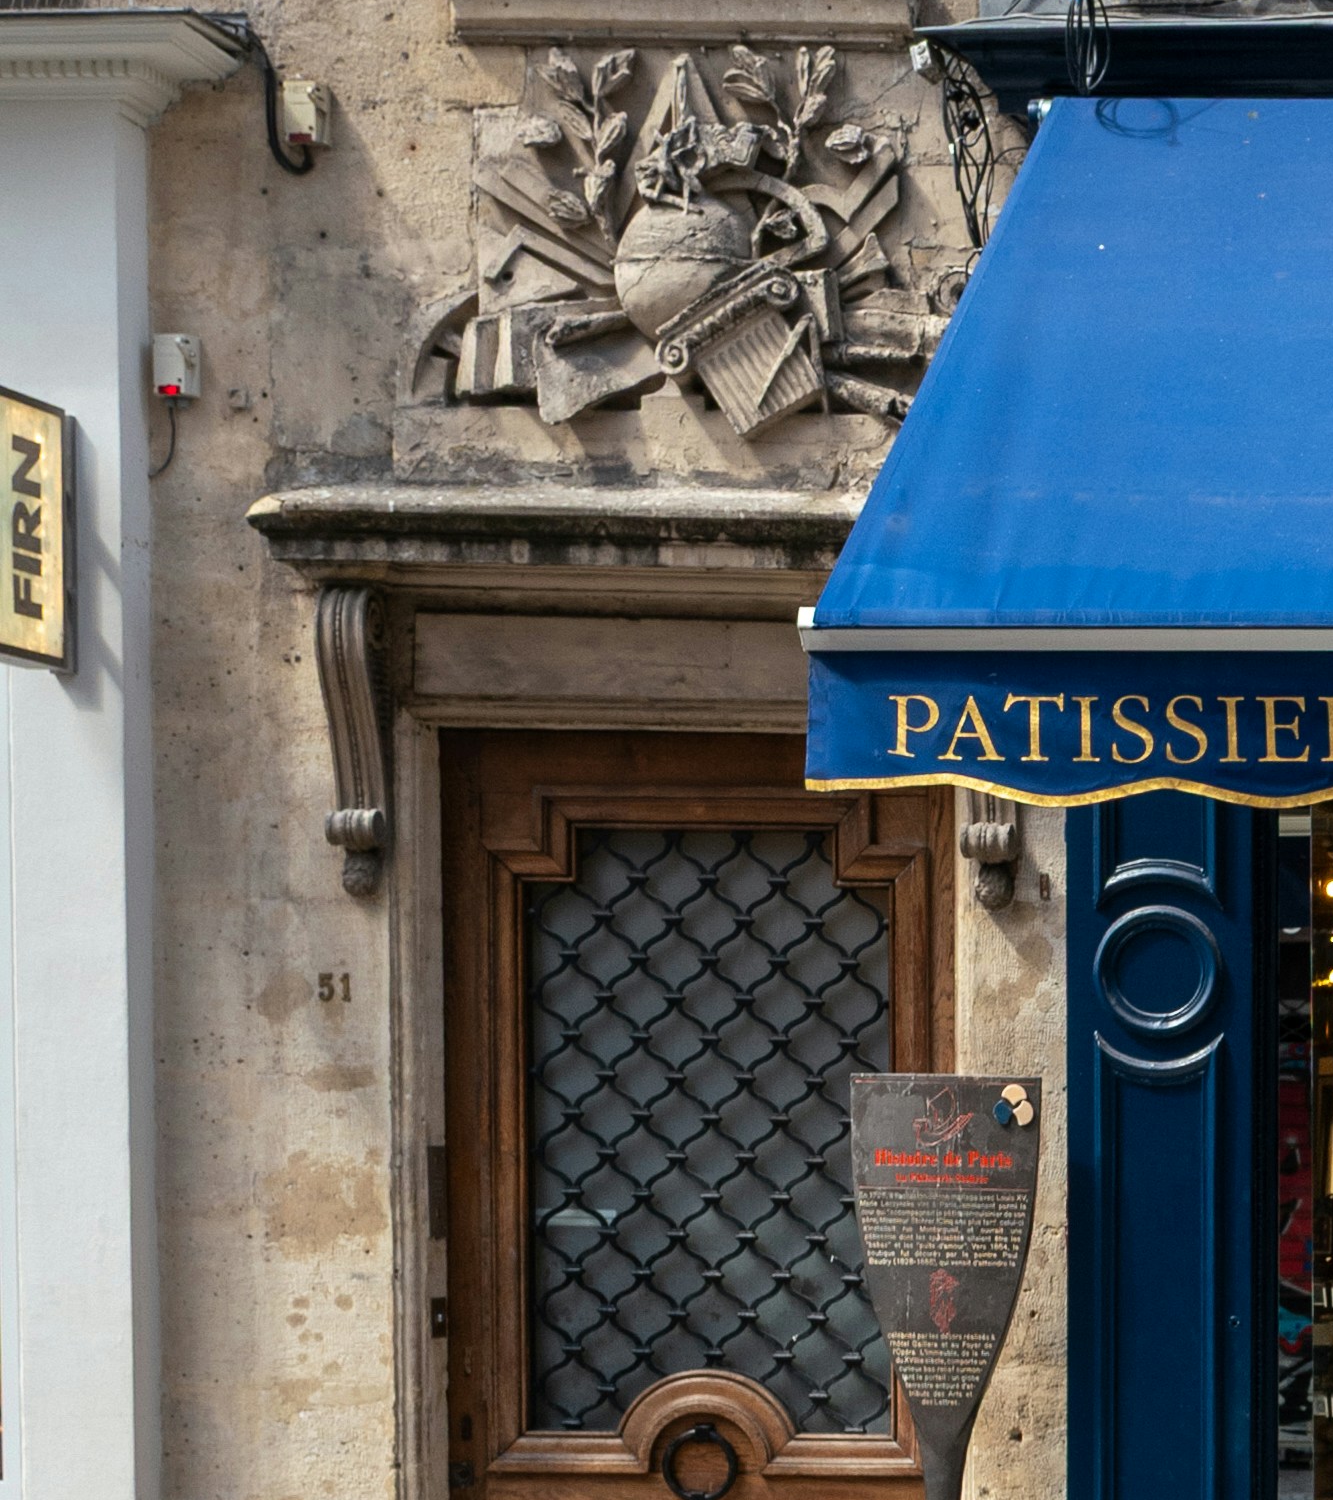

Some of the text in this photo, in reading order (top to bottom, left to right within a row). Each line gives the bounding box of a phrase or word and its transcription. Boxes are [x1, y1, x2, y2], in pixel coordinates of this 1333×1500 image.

[12, 434, 43, 621] FIRN
[318, 972, 351, 1002] 51
[875, 1150, 938, 1167] Histoire
[968, 1151, 1013, 1168] Paris
